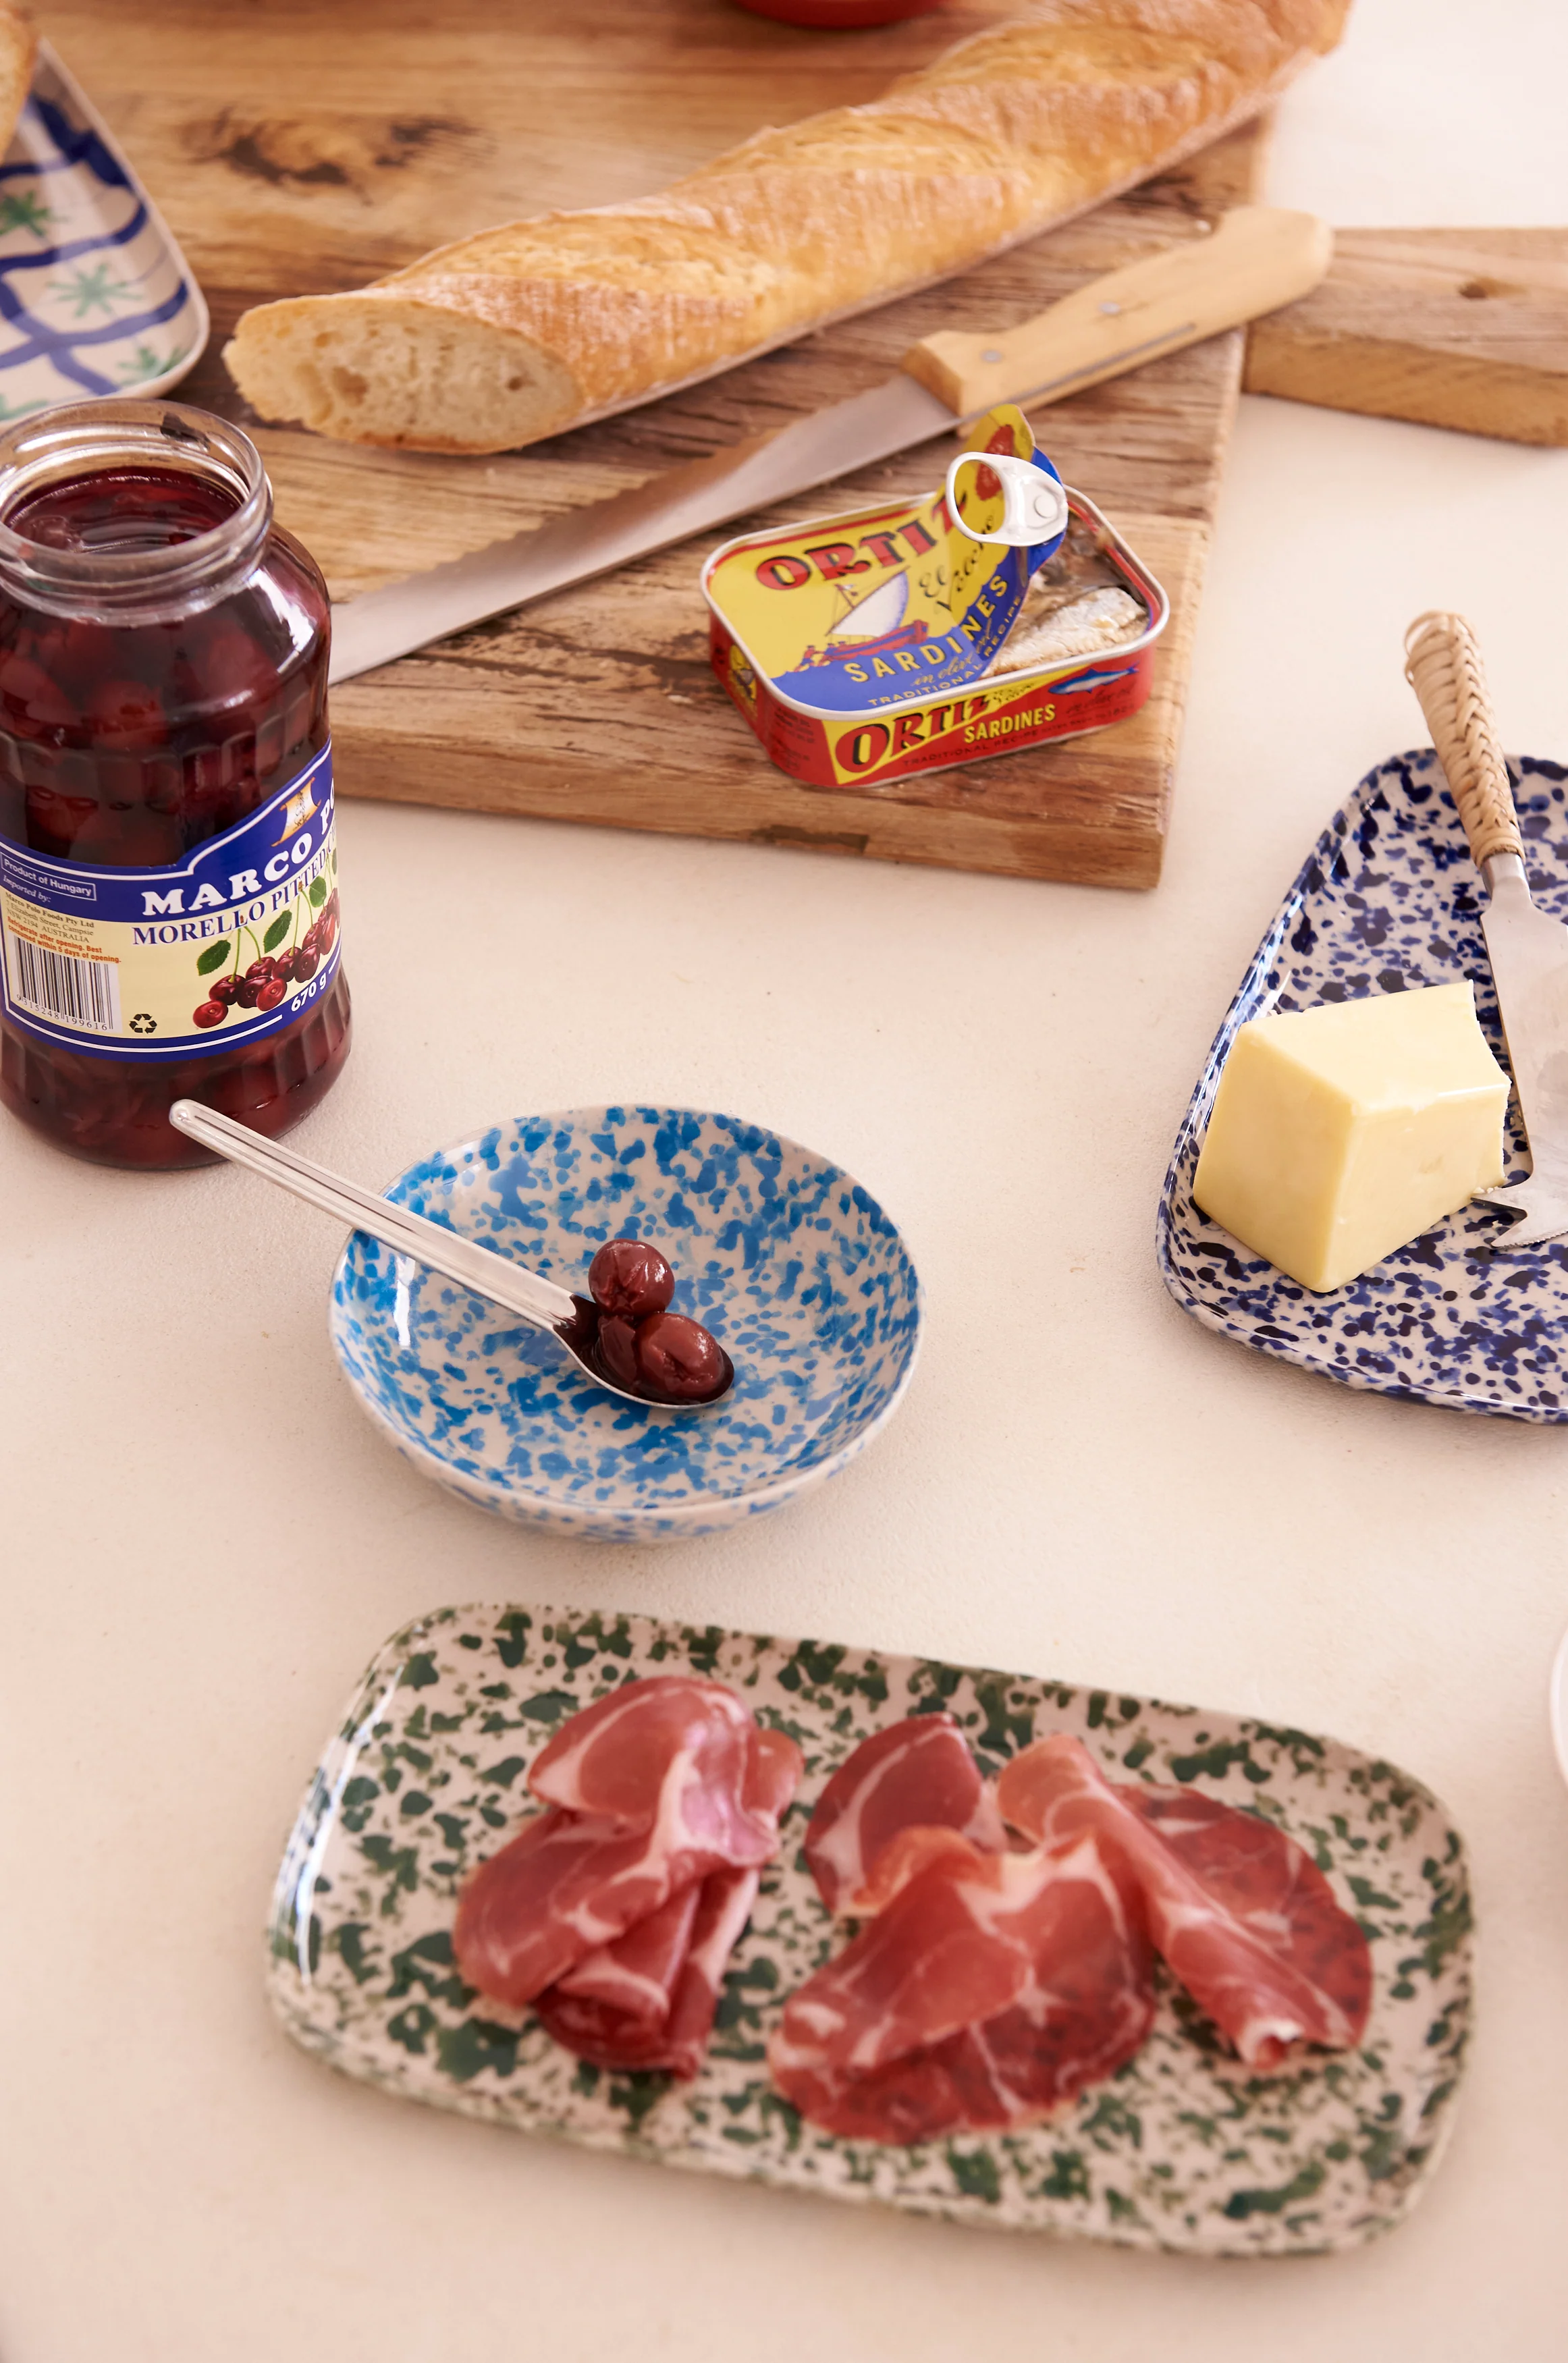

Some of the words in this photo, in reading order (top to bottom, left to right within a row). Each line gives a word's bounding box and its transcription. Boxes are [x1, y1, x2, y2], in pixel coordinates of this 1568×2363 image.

[844, 575, 1008, 683] SARDINES
[867, 663, 983, 706] TRADITIONAL
[835, 694, 989, 773] ORTIZ
[963, 703, 1056, 744] SARDINES
[3, 875, 36, 897] Imported
[38, 892, 51, 902] by:
[4, 858, 36, 881] Product
[38, 877, 48, 885] of
[50, 879, 92, 896] Hungary
[141, 833, 313, 916] MARCO
[5, 892, 25, 906] Marco
[26, 903, 41, 914] Polo
[43, 910, 63, 921] Foods
[65, 917, 78, 925] Pty
[80, 920, 94, 928] Ltd
[133, 901, 265, 945] MORELLO
[271, 848, 326, 912] PITTED
[7, 916, 38, 937] Refrigerate
[39, 933, 55, 942] after
[56, 940, 85, 951] opening.
[86, 945, 103, 953] Best
[8, 925, 36, 943] consumed
[37, 940, 57, 951] within
[64, 948, 80, 957] days
[90, 954, 121, 964] opening.
[23, 918, 38, 928] 2194
[42, 926, 90, 943] AUSTRALIA
[62, 924, 94, 935] Campsie
[291, 981, 317, 1012] 670
[319, 973, 327, 990] g
